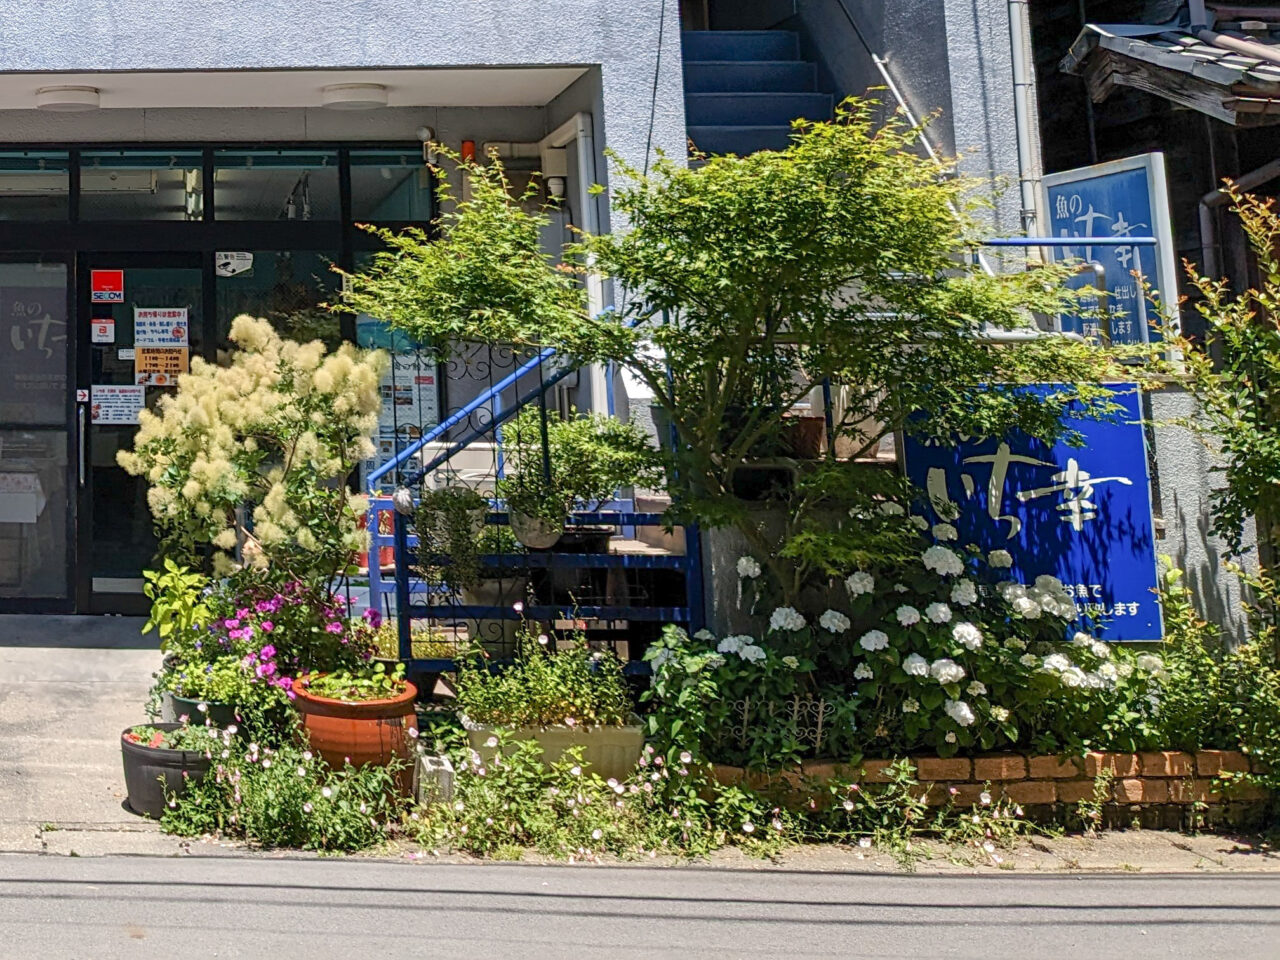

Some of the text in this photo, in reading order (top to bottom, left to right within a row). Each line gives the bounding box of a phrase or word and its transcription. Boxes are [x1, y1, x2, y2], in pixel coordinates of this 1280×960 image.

[1055, 194, 1083, 219] 魚の
[93, 292, 122, 300] SECOM
[10, 301, 42, 317] 魚の
